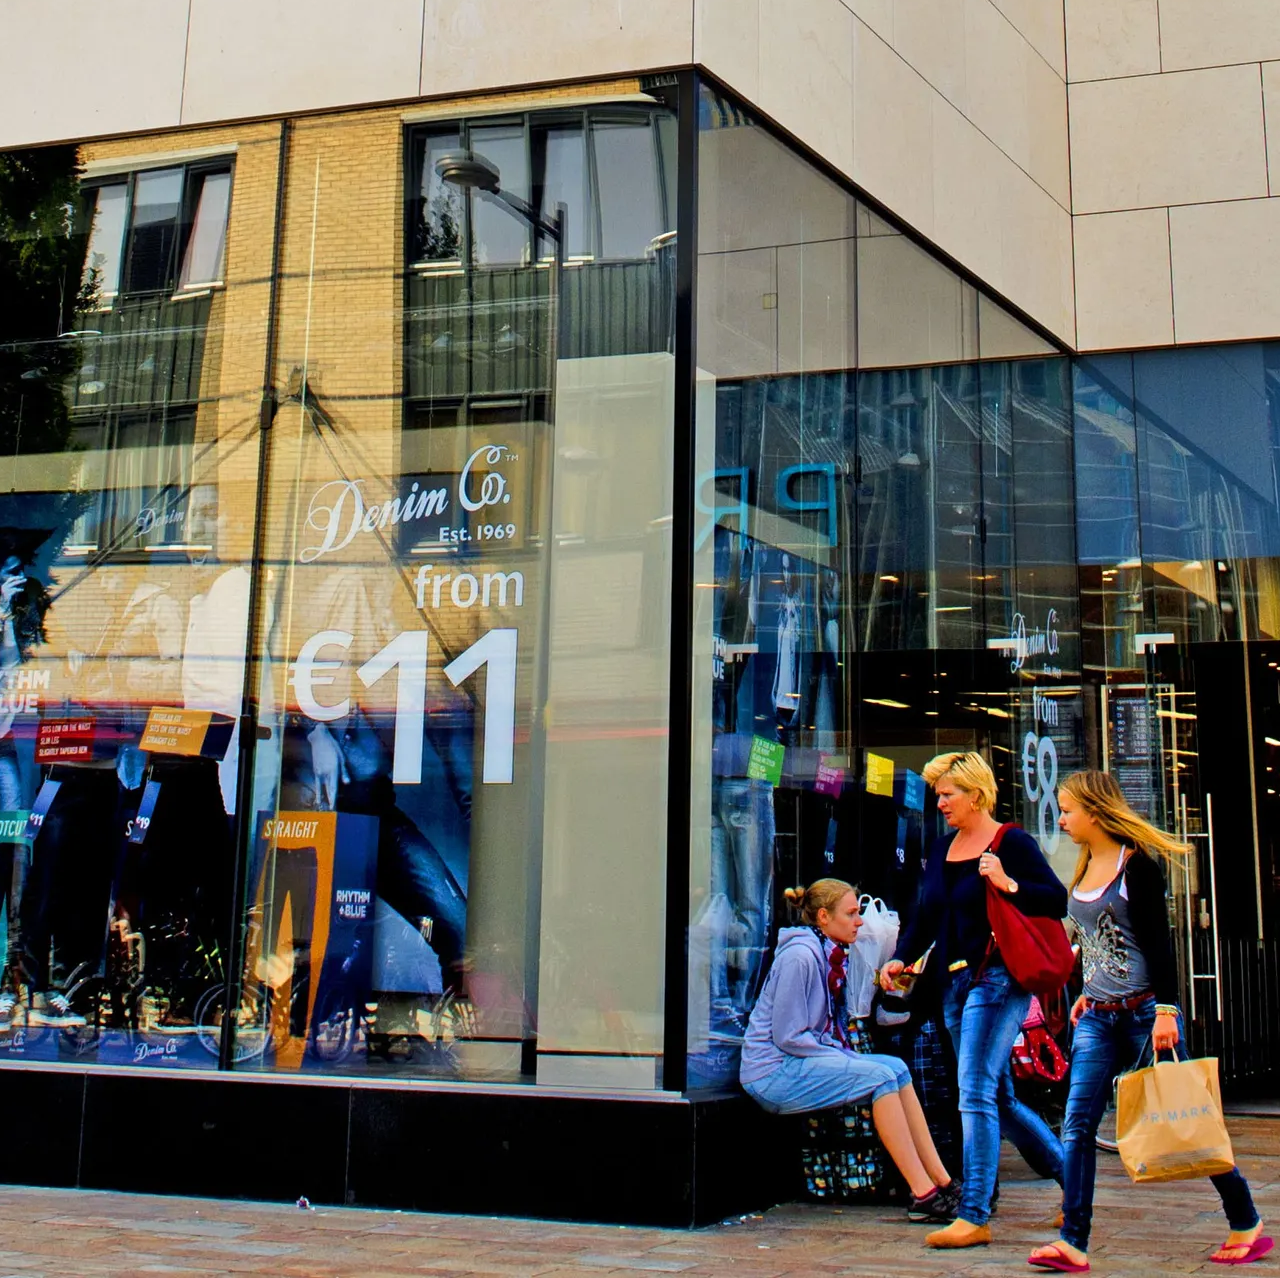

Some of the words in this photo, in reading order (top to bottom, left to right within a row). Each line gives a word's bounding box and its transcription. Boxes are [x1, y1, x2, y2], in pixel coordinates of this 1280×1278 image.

[300, 479, 449, 563] Denim
[440, 527, 472, 542] Est.
[477, 523, 516, 540] 1969
[414, 564, 524, 609] from
[287, 627, 518, 785] €11
[1033, 685, 1058, 726] from
[1022, 730, 1059, 855] €8
[264, 820, 319, 839] STRAIGHT
[336, 890, 370, 903] RHYTHM
